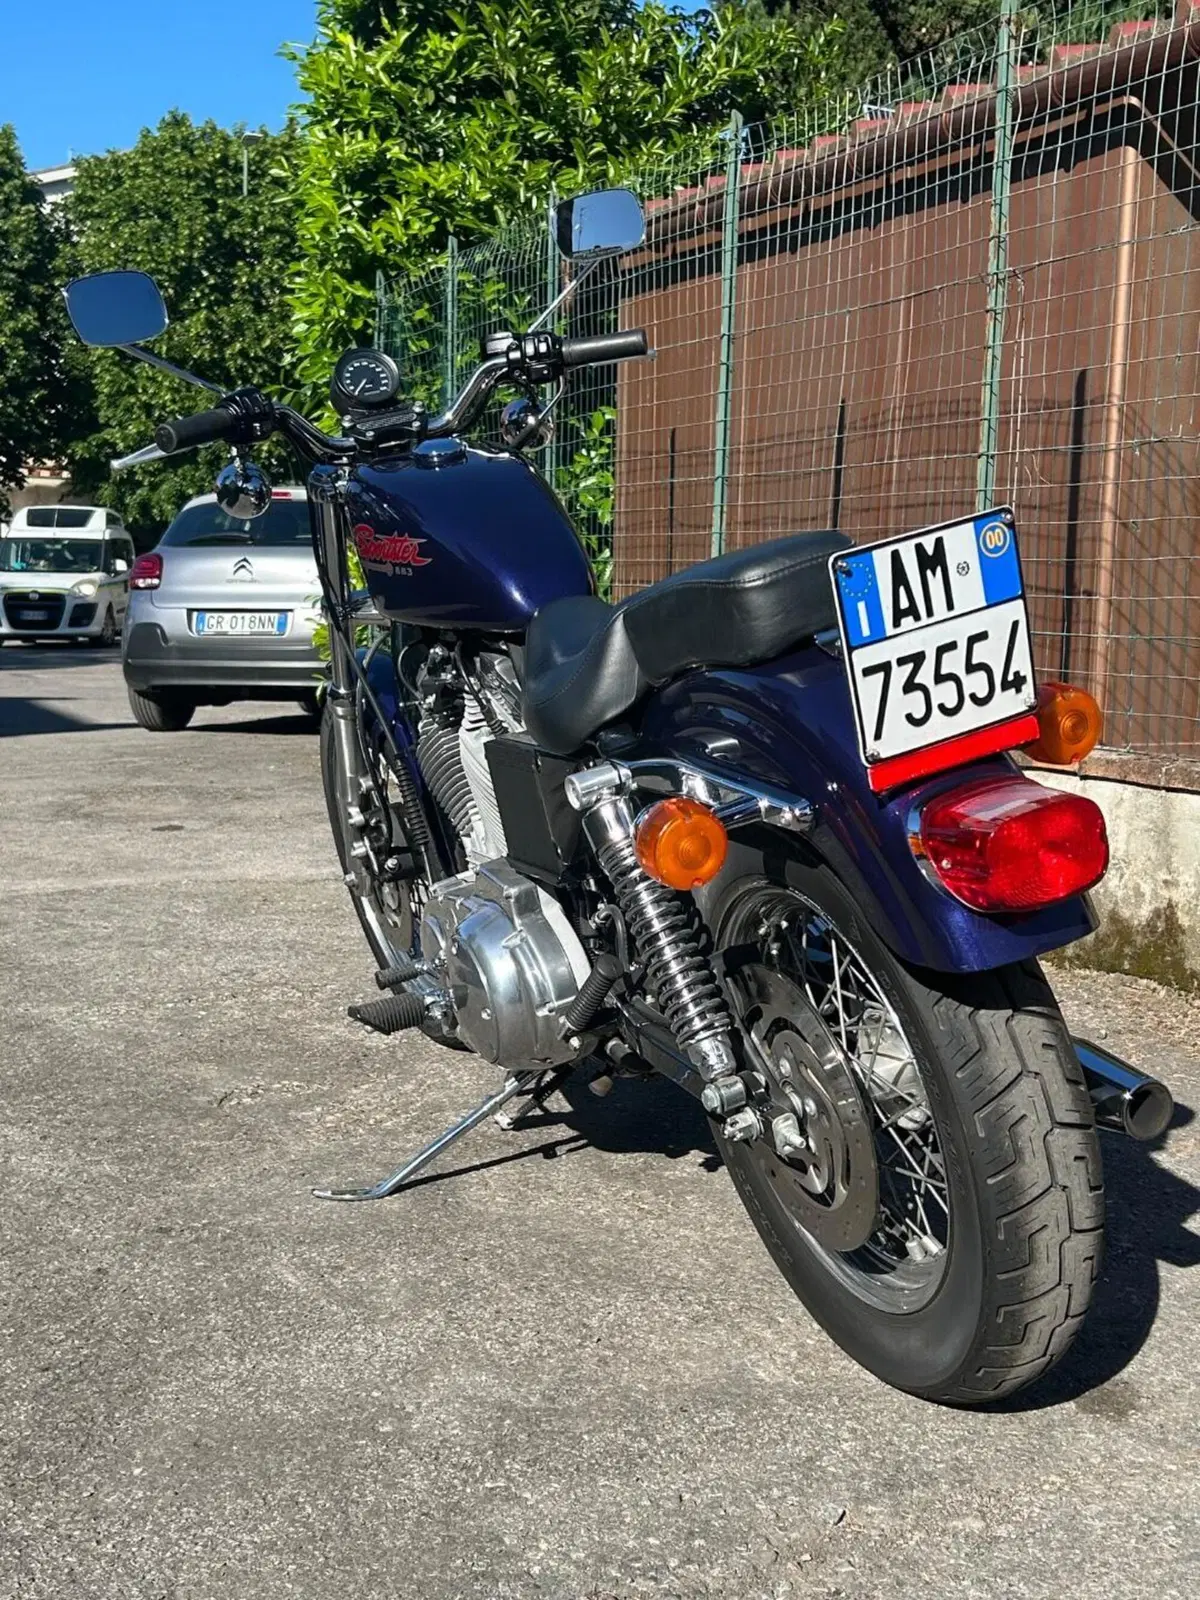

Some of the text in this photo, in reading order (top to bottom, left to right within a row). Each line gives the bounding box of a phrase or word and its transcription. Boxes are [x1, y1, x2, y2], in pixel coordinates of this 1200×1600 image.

[985, 528, 1004, 549] 00
[890, 536, 954, 629] AM
[206, 615, 276, 630] GR 018NN
[857, 601, 871, 637] I
[861, 619, 1027, 741] 73554
